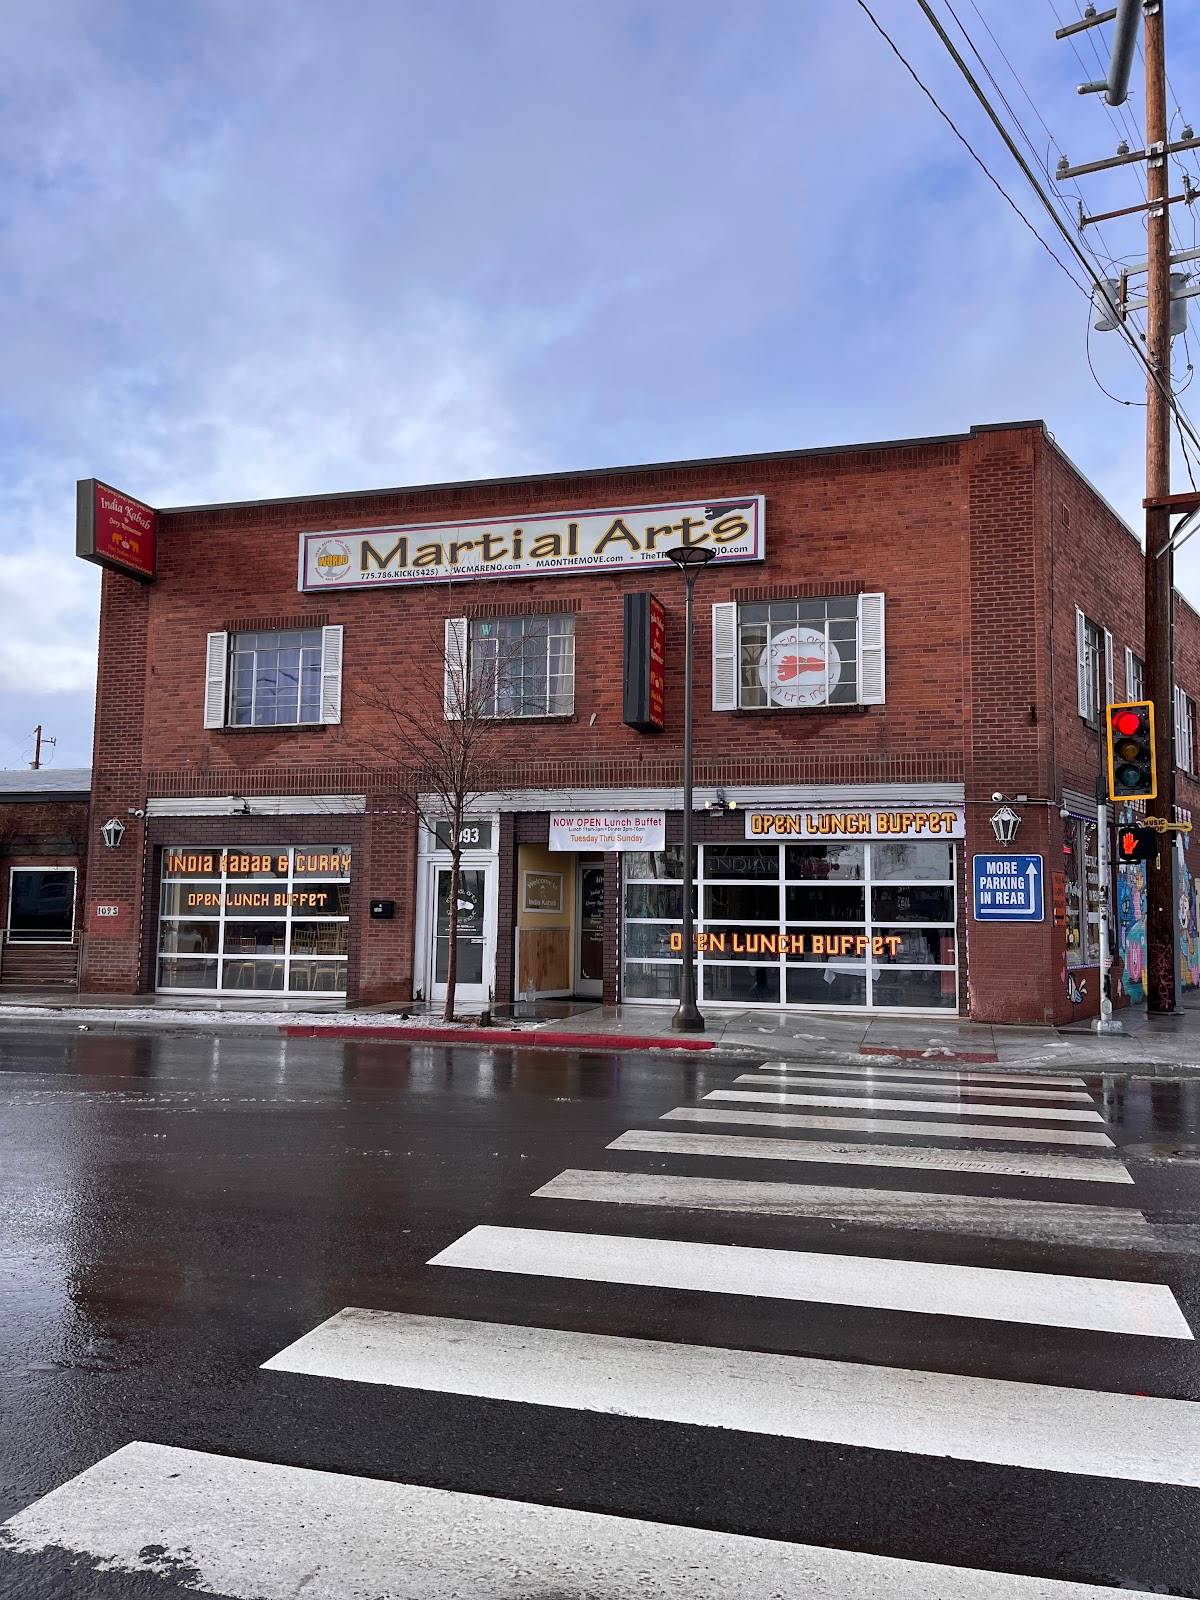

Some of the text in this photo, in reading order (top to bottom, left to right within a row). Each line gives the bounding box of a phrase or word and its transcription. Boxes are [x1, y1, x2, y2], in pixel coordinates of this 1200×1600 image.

[101, 497, 123, 513] India
[125, 506, 151, 530] Kabab
[359, 522, 579, 571] Martial
[592, 514, 750, 554] Arts
[318, 554, 349, 567] WORLD
[360, 567, 439, 580] 775.786.KICK(5425)
[453, 563, 521, 574] WCMARENO.com
[536, 555, 623, 567] MAONTHEMOVE.com
[553, 817, 662, 827] NOW OPEN Lunch Buffet
[751, 812, 958, 834] OPEN LUNCH BUFFET
[571, 834, 643, 844] Tuesday Thru Sunday
[168, 854, 351, 872] INDIA KABAB & CURRY
[986, 861, 1018, 874] MORE
[980, 877, 1025, 889] PARKING
[188, 893, 328, 906] OPEN LUNCH BUFFET
[980, 892, 1025, 905] IN REAR
[669, 932, 901, 956] OEN LUNCH BUFFET
